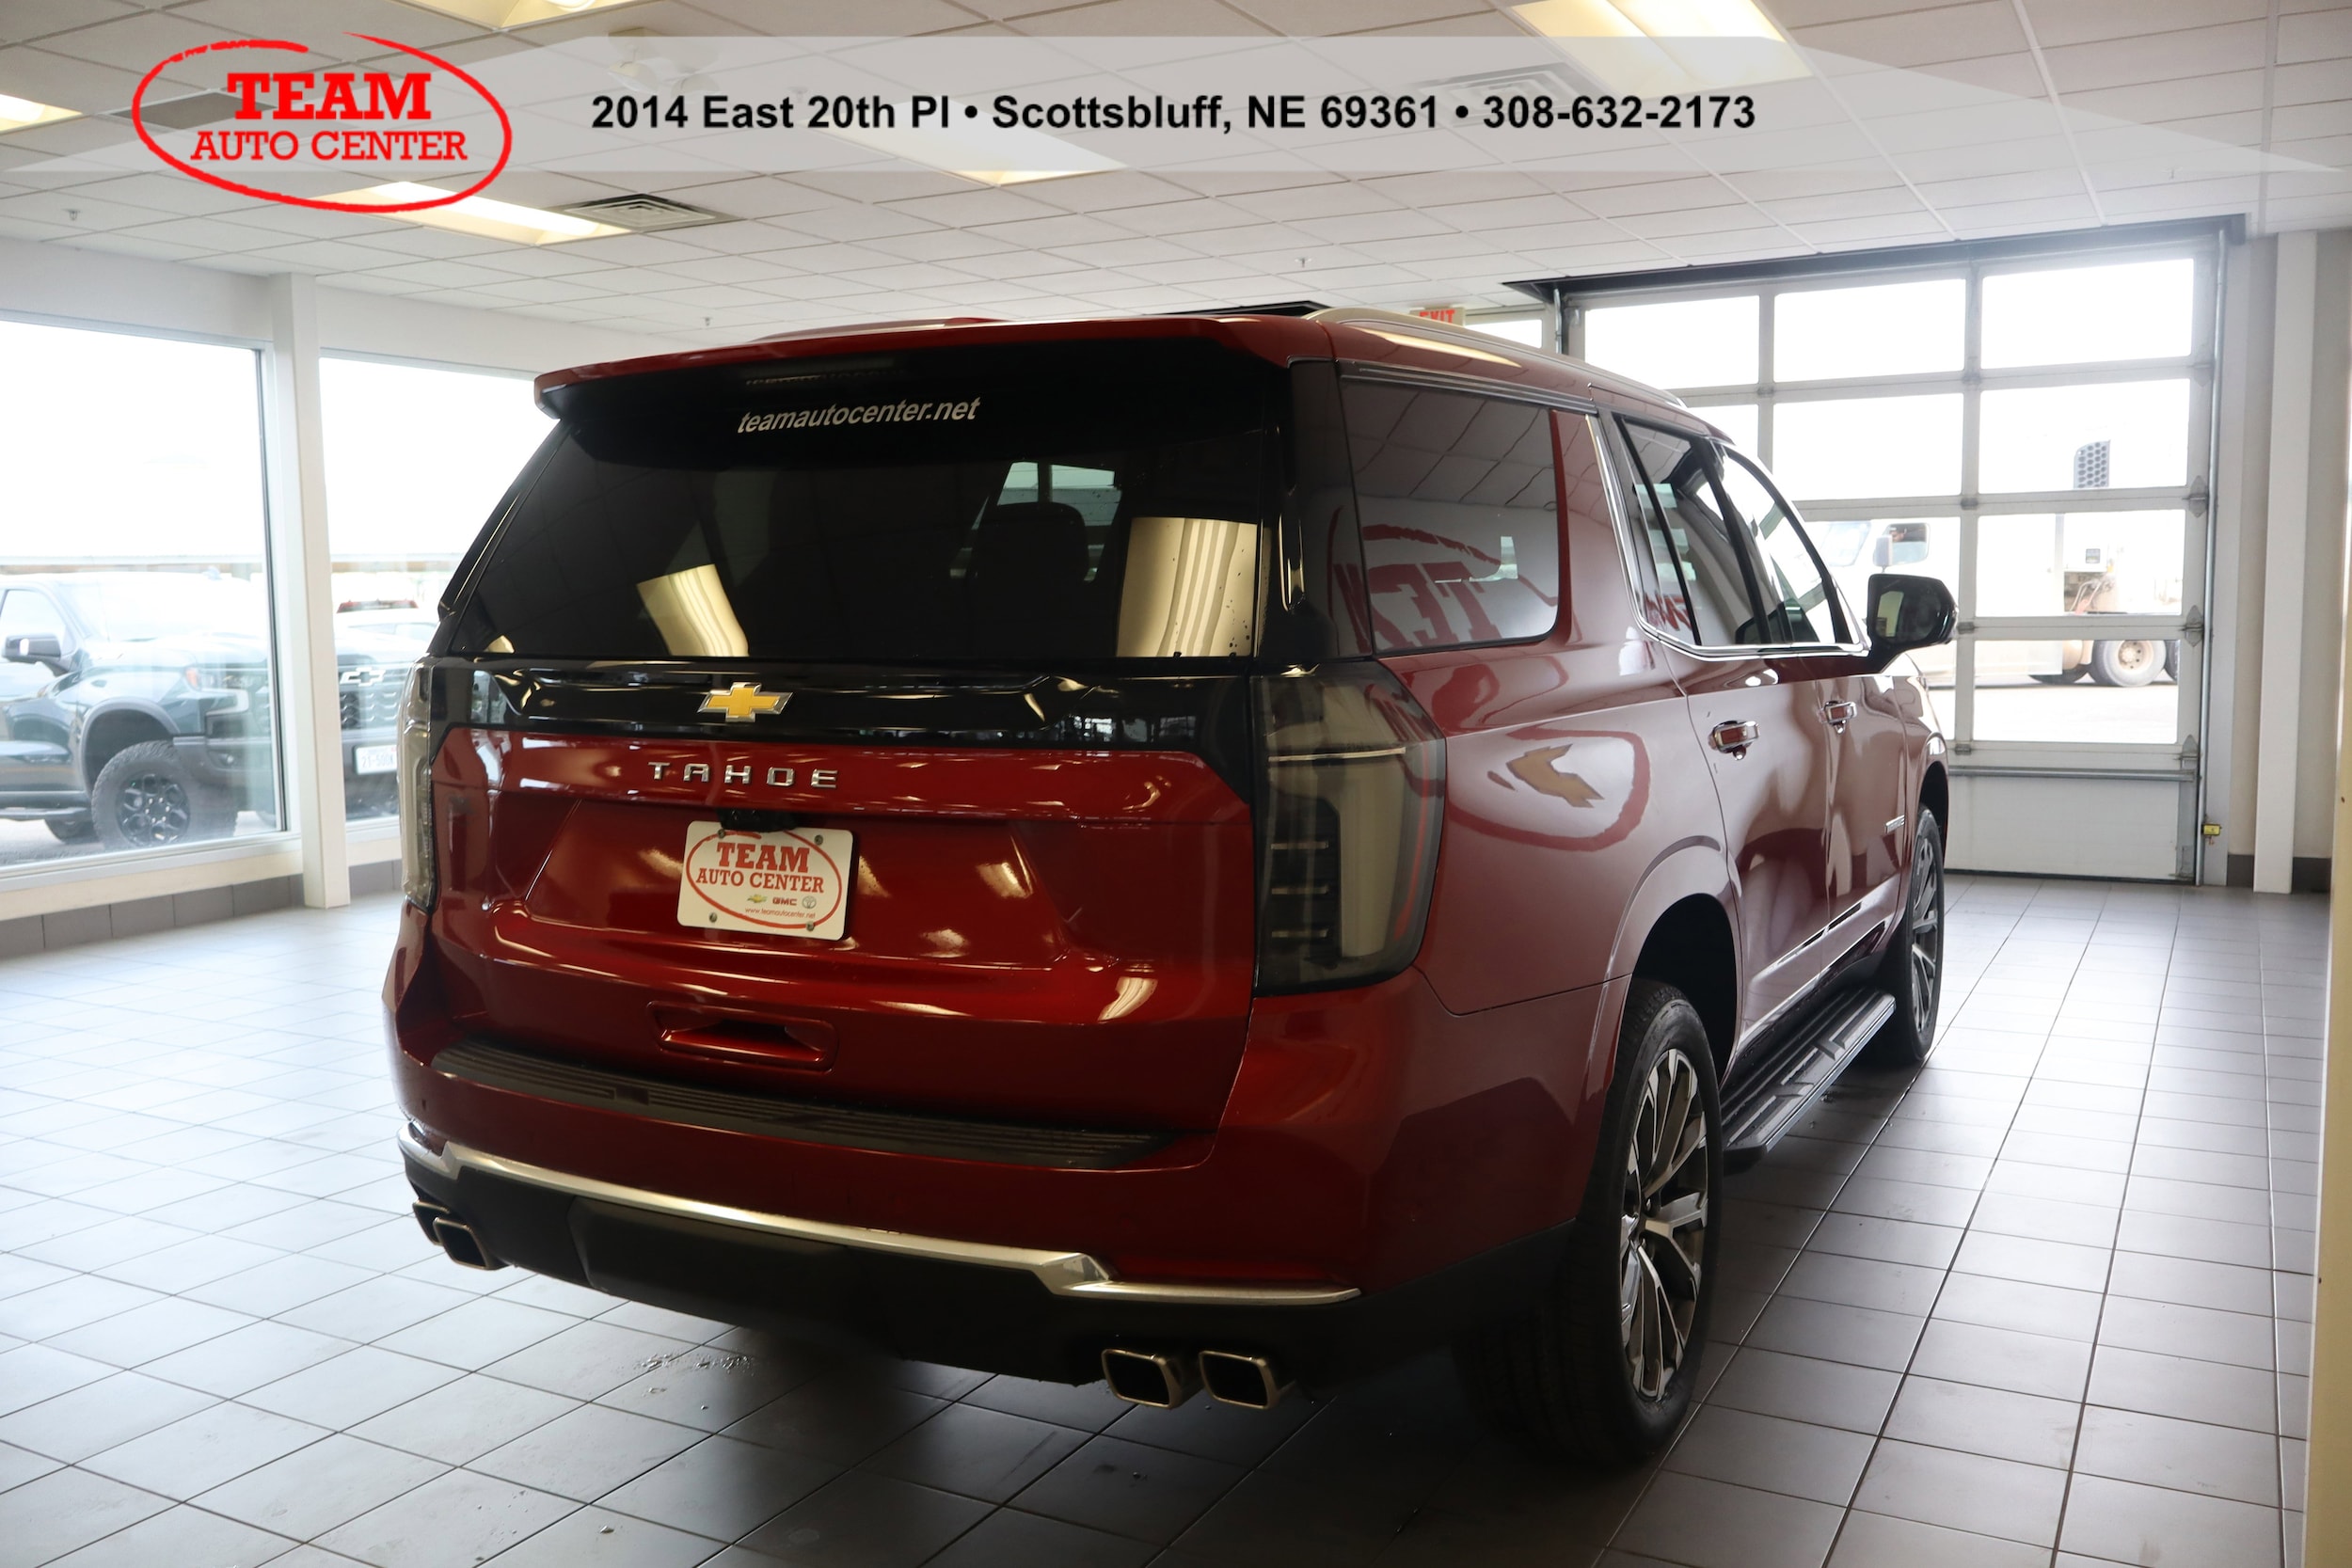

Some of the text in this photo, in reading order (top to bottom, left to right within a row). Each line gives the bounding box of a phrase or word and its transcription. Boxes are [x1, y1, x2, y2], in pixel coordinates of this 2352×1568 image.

[738, 396, 981, 434] teamautocenter.net
[647, 761, 838, 788] TAHOE
[716, 842, 810, 873] TEAM
[696, 868, 824, 894] AUTO CENTER
[745, 908, 817, 919] www.teamautocenter.net
[772, 896, 798, 906] GMC
